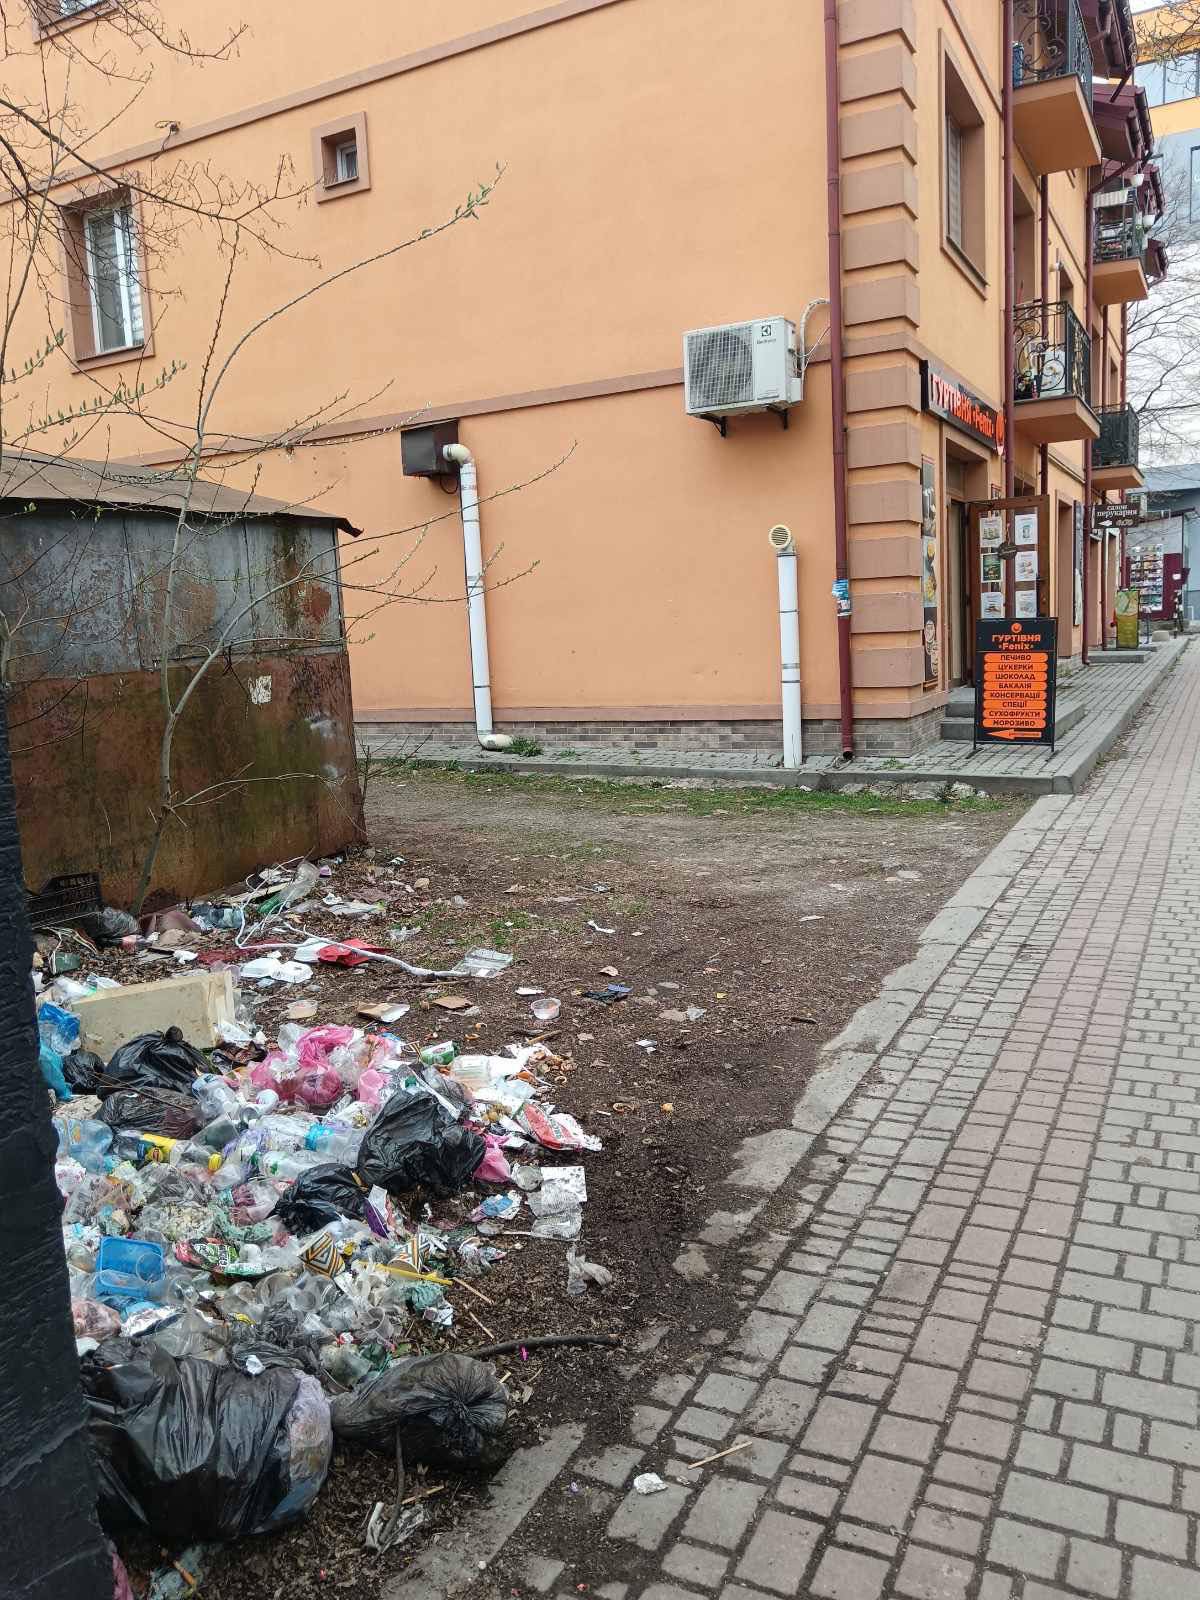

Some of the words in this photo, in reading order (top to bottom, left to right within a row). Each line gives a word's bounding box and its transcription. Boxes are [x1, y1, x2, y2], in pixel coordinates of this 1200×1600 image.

[932, 373, 972, 425] ГУРТІВНЯ
[1097, 509, 1137, 518] перукарня
[991, 634, 1041, 642] ГУРТІВНЯ
[998, 663, 1034, 671] ЦУКЕРКИ
[988, 710, 1041, 718] СУХОФРУКТИ
